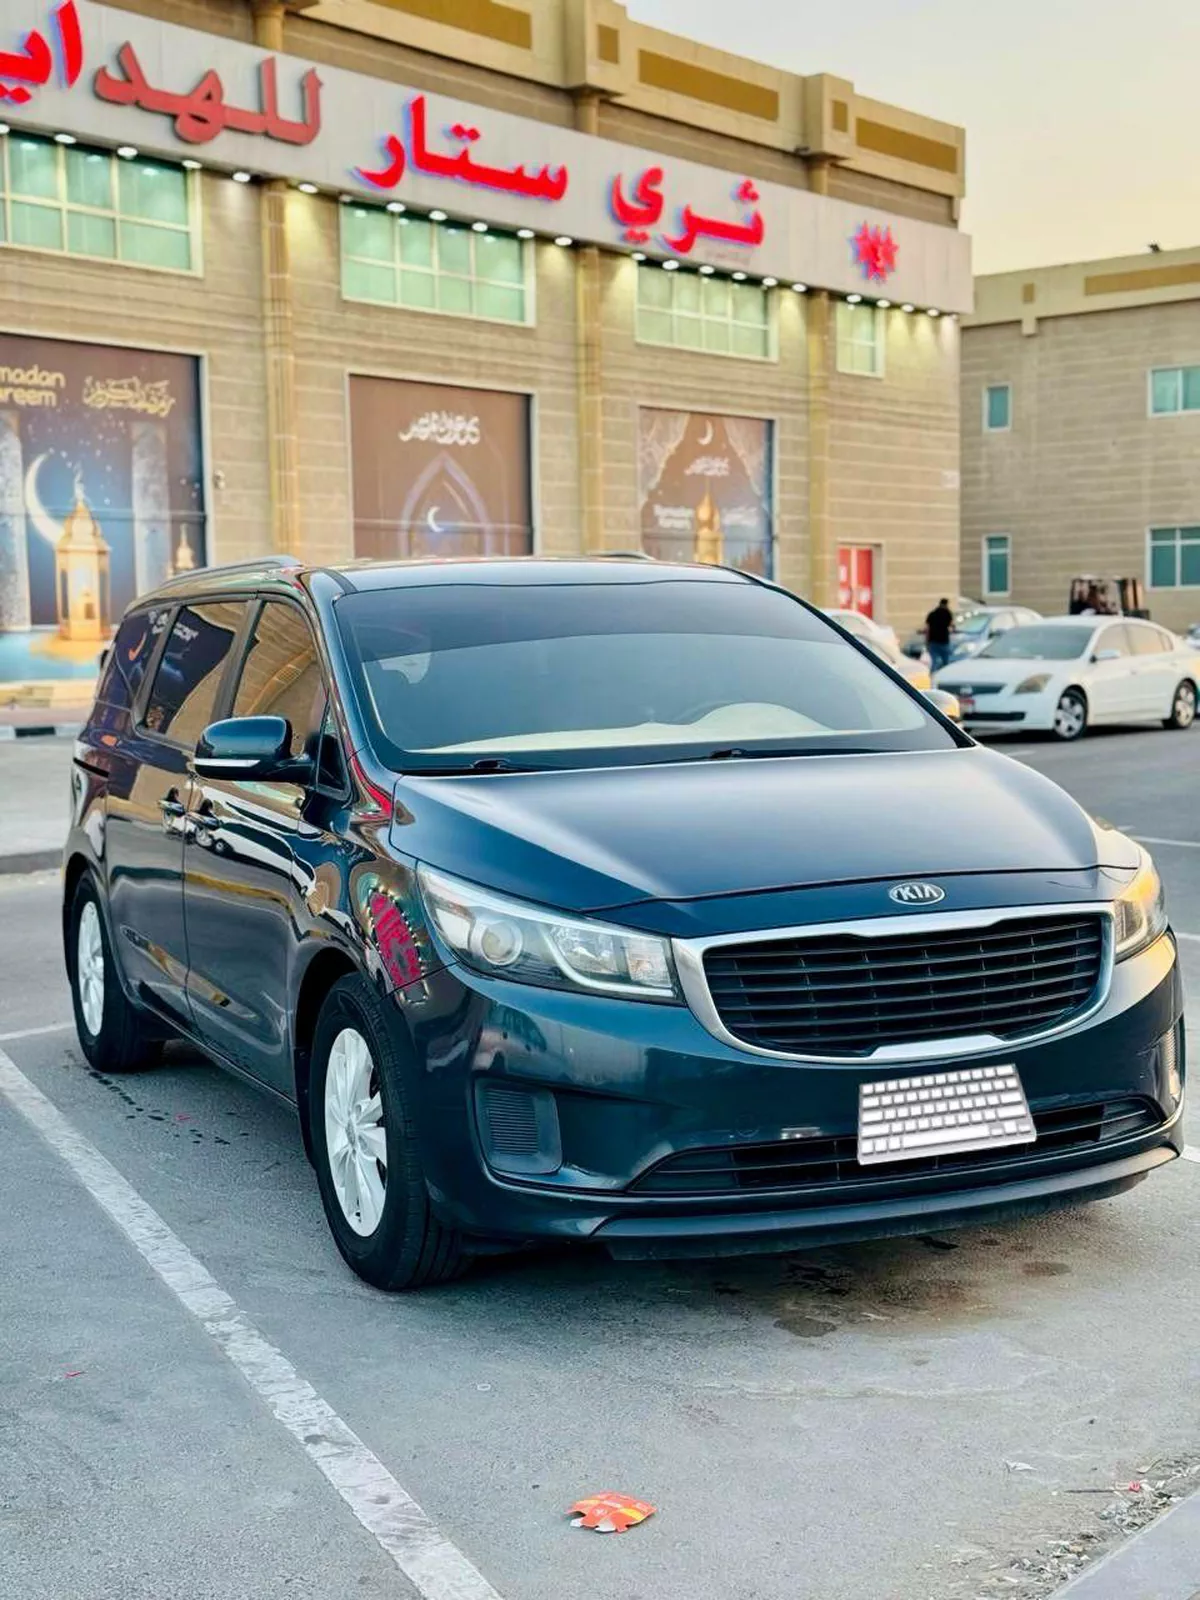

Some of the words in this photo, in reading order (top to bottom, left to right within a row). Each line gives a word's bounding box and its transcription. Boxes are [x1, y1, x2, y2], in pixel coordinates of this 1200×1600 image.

[356, 95, 569, 201] ستار
[611, 166, 766, 255] ثري
[892, 884, 940, 901] KIA
